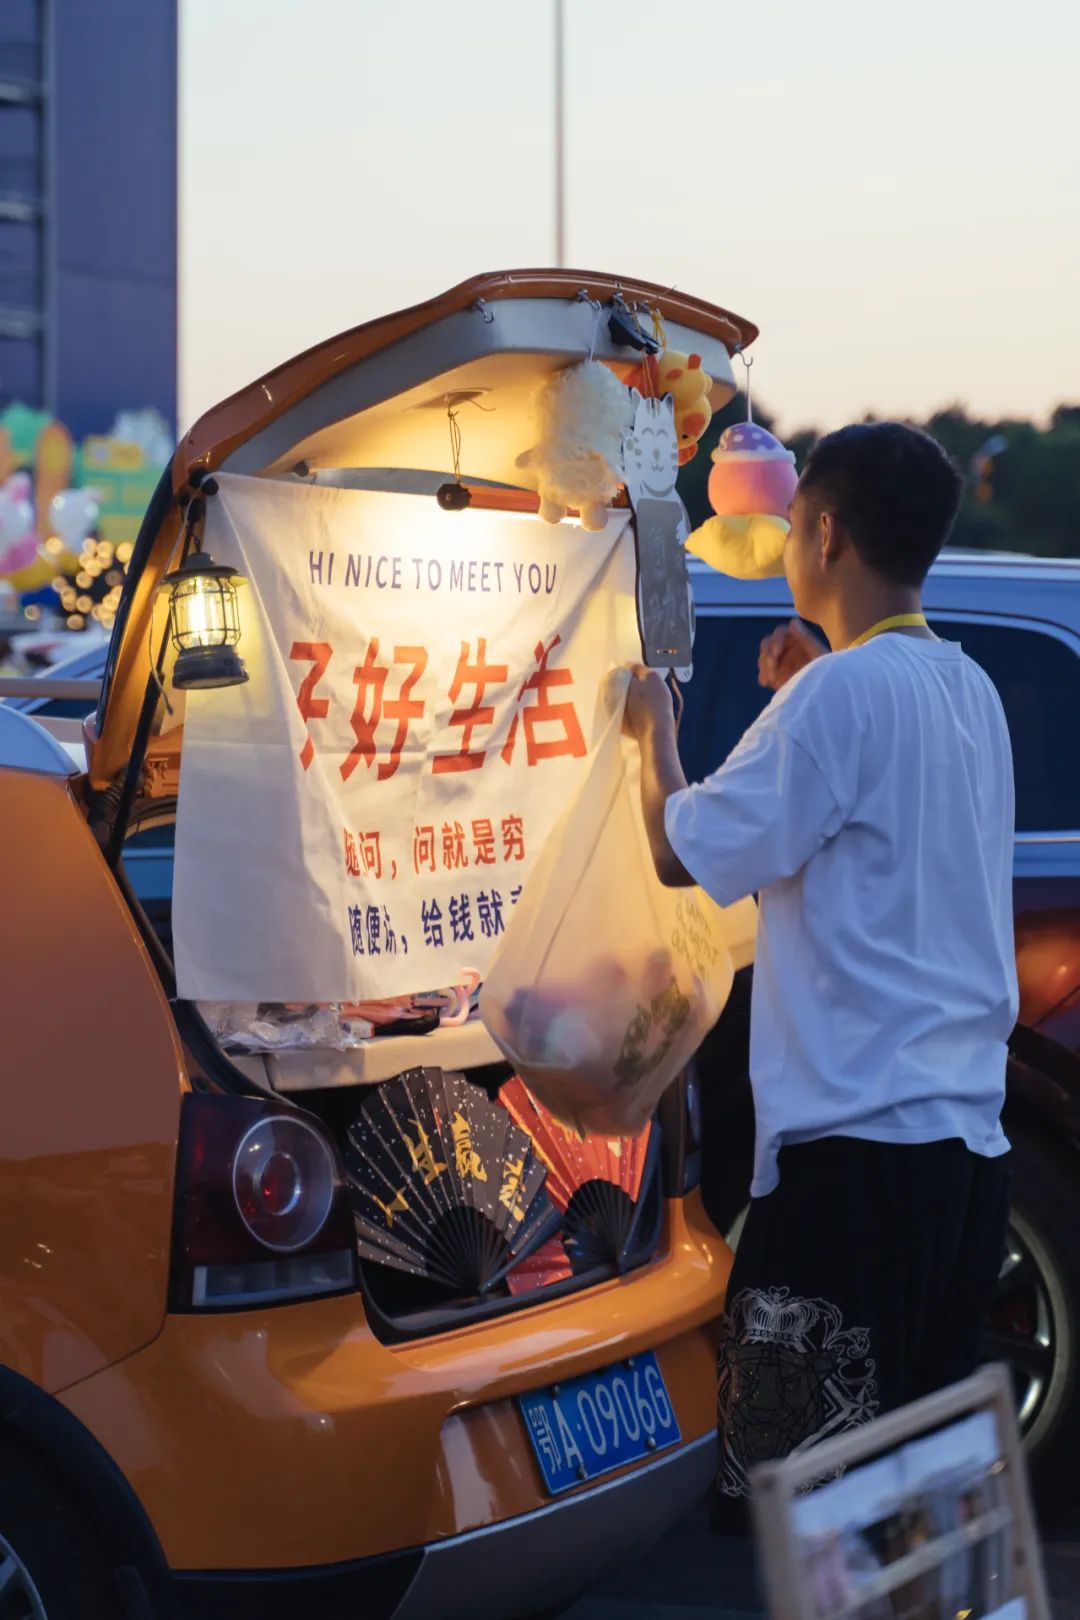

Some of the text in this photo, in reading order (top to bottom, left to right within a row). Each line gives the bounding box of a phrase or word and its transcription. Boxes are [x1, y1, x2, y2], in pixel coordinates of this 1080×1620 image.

[309, 550, 557, 595] HI NICE TO MEET YOU
